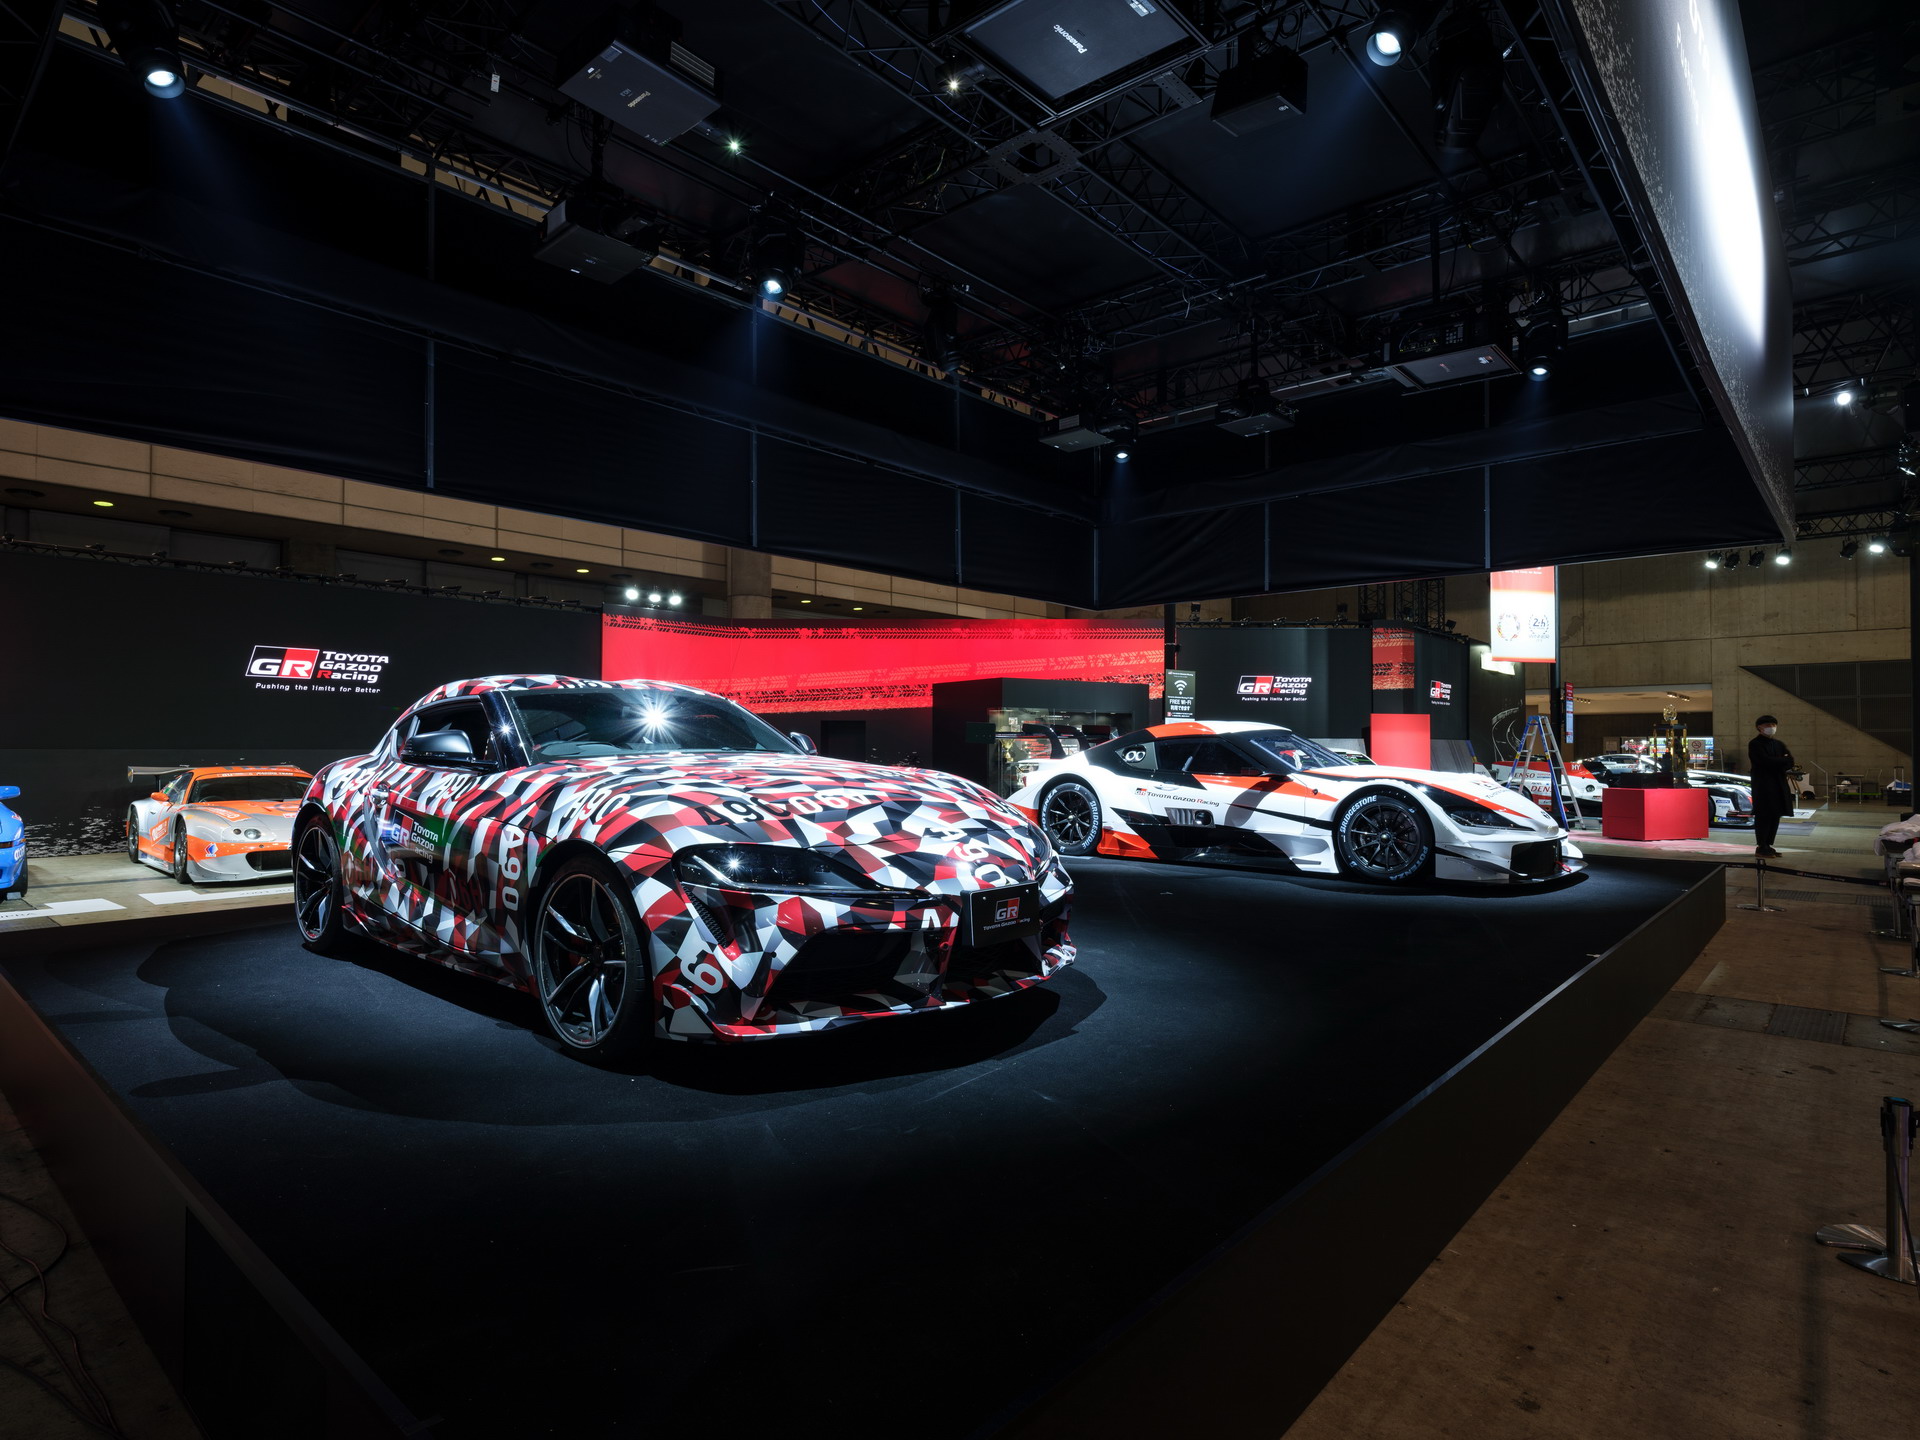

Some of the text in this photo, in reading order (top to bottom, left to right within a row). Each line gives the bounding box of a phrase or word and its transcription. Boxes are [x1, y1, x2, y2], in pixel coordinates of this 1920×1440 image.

[1053, 24, 1087, 54] Panasonic
[319, 660, 382, 672] GAZOO
[322, 651, 389, 663] TOYOTA
[250, 658, 312, 677] GR
[316, 669, 379, 684] Racing
[255, 682, 290, 691] Pushing
[1239, 683, 1271, 694] GR
[1508, 771, 1536, 779] ENSO
[1531, 785, 1552, 793] DEN
[563, 787, 631, 823] A90
[1147, 791, 1220, 807] TOYOTA GAZOO Racing
[1041, 788, 1058, 832] POTENZA
[1340, 794, 1378, 834] BRIDGESTONE
[413, 821, 439, 842] TOYOTA
[1081, 800, 1099, 849] BRIDGESTONE
[391, 823, 410, 847] GR
[411, 832, 435, 852] GAZOO
[411, 844, 433, 864] acing
[500, 825, 525, 911] A90
[996, 906, 1018, 920] GR
[983, 923, 1000, 931] TOYOTA
